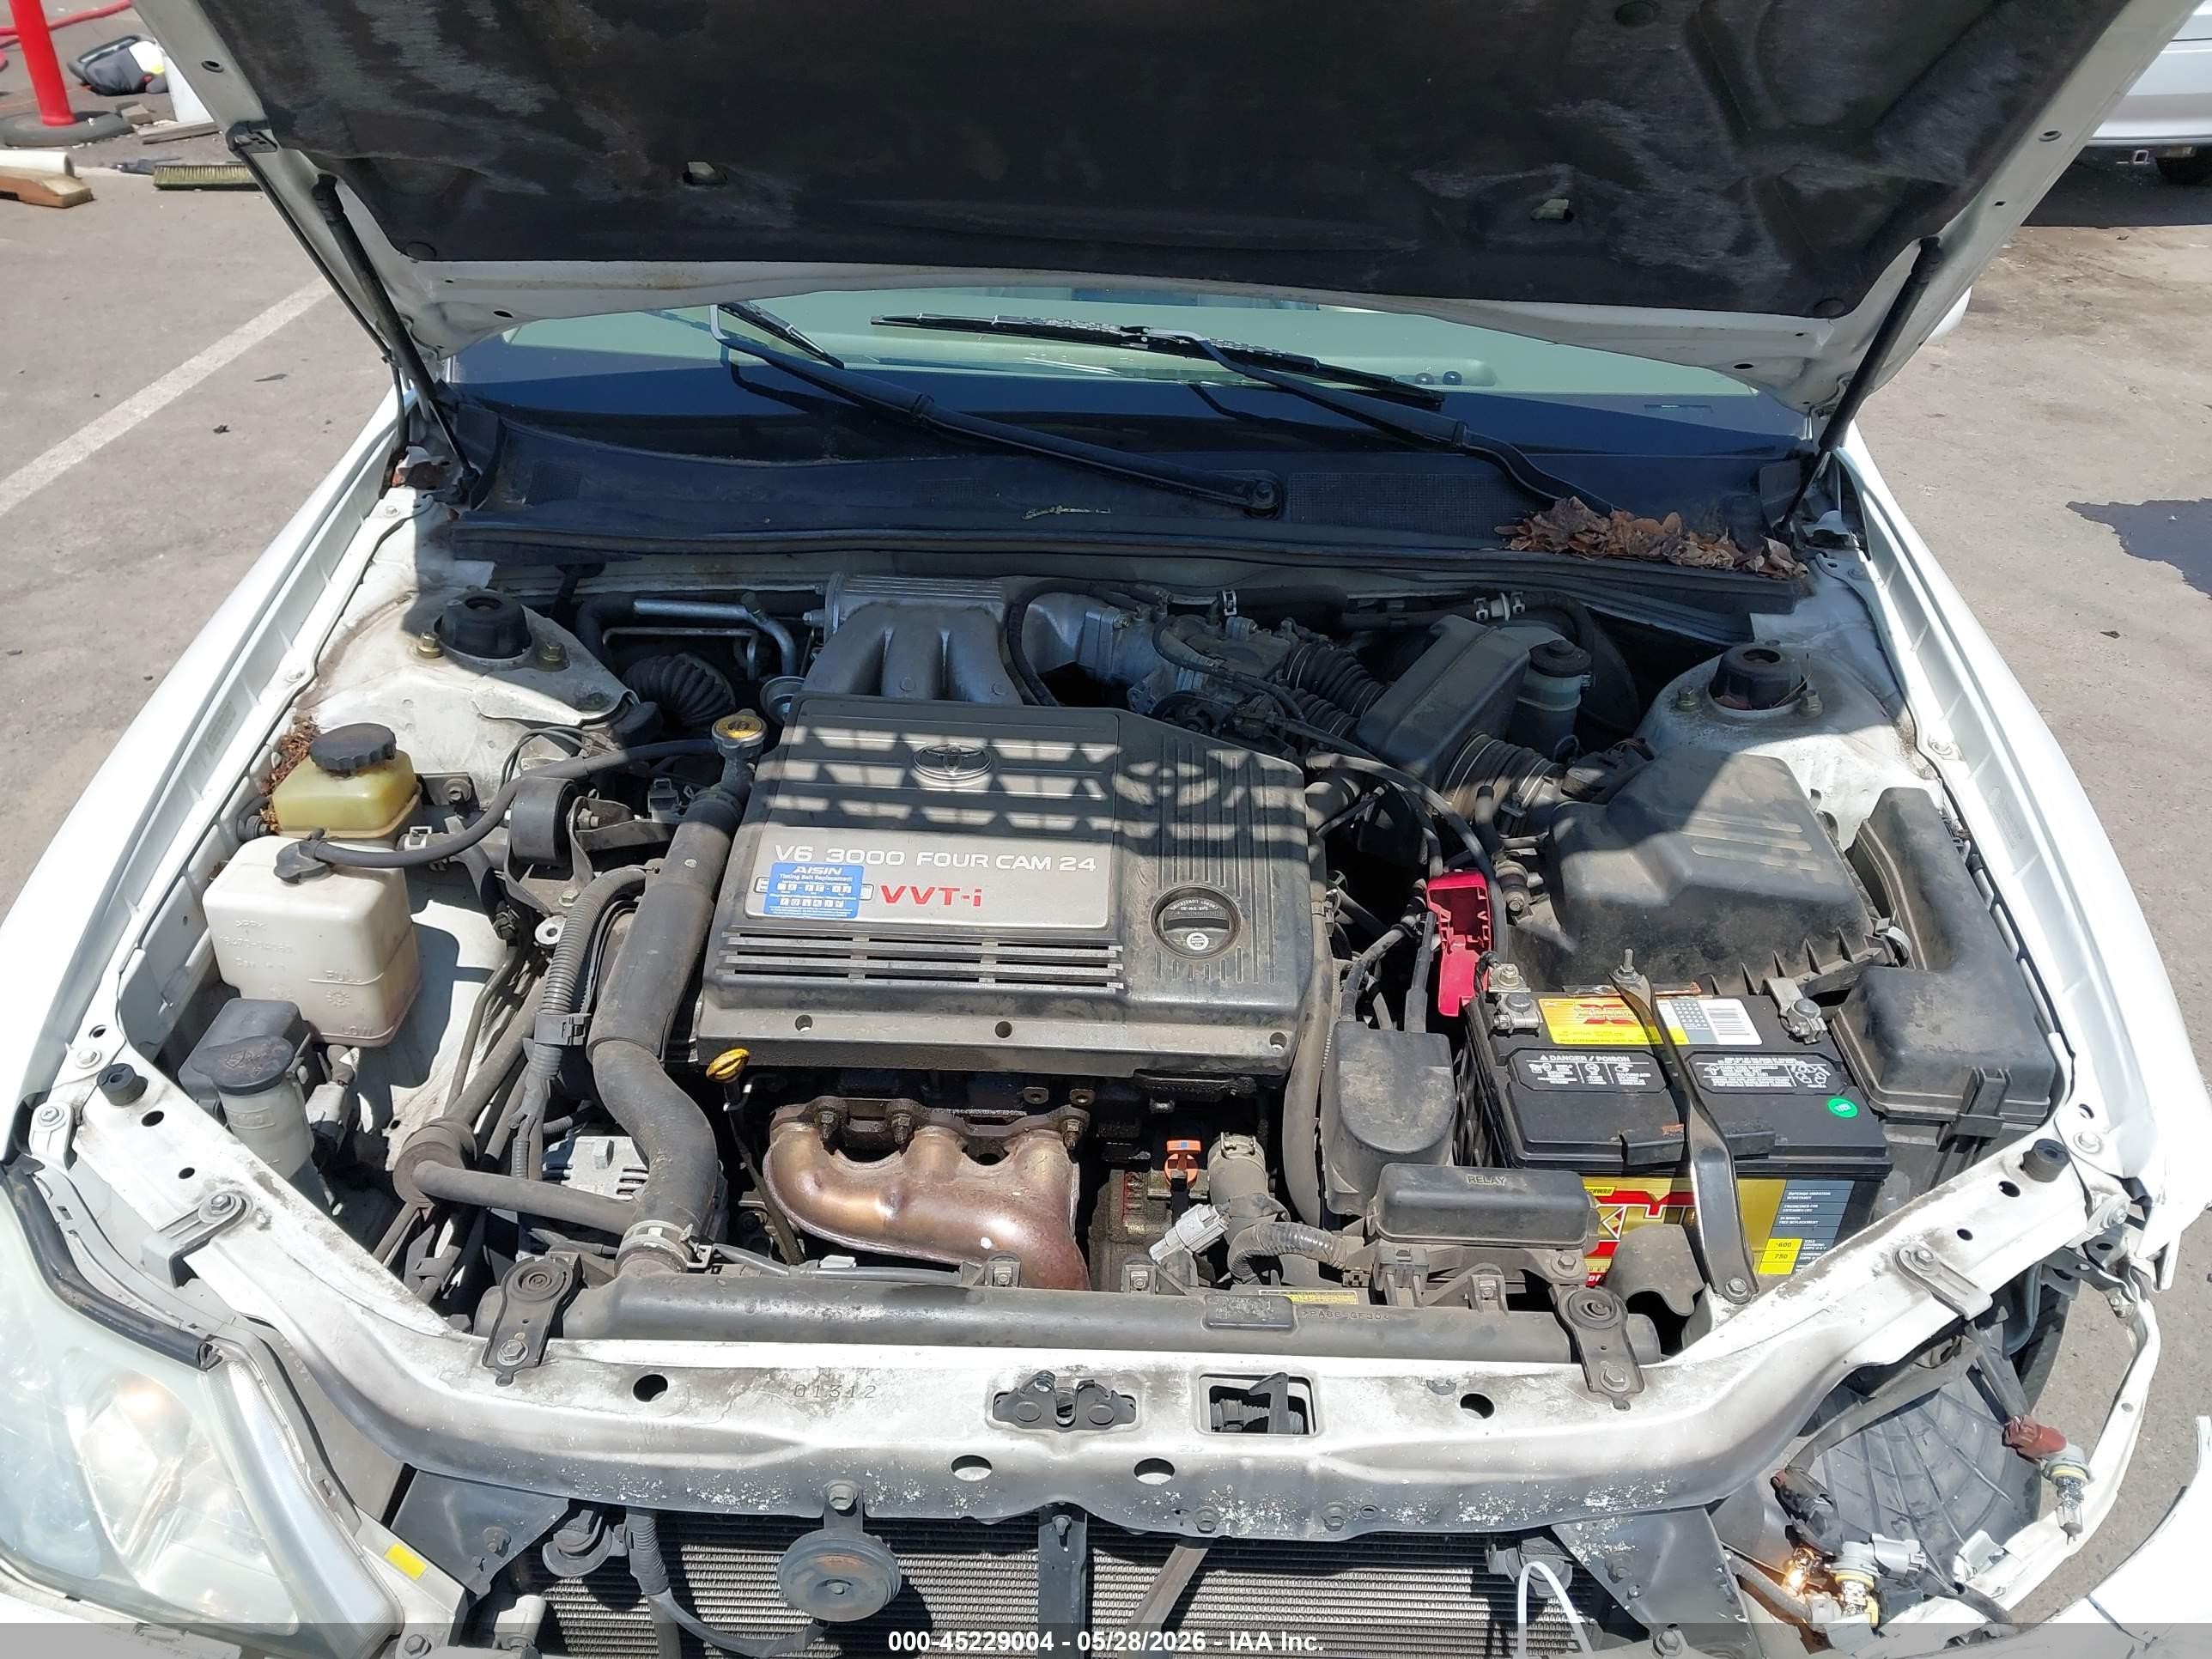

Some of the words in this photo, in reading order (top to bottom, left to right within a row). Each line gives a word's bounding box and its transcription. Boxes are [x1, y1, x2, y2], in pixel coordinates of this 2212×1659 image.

[775, 845, 813, 862] V6
[825, 848, 905, 866] 3000
[916, 851, 989, 868] FOUR
[994, 854, 1052, 871] CAM
[1059, 855, 1097, 873] 24
[793, 866, 842, 875] AISIN
[880, 885, 984, 908] VVT-i
[1468, 1175, 1505, 1186] RELAY
[793, 1383, 877, 1399] 01312
